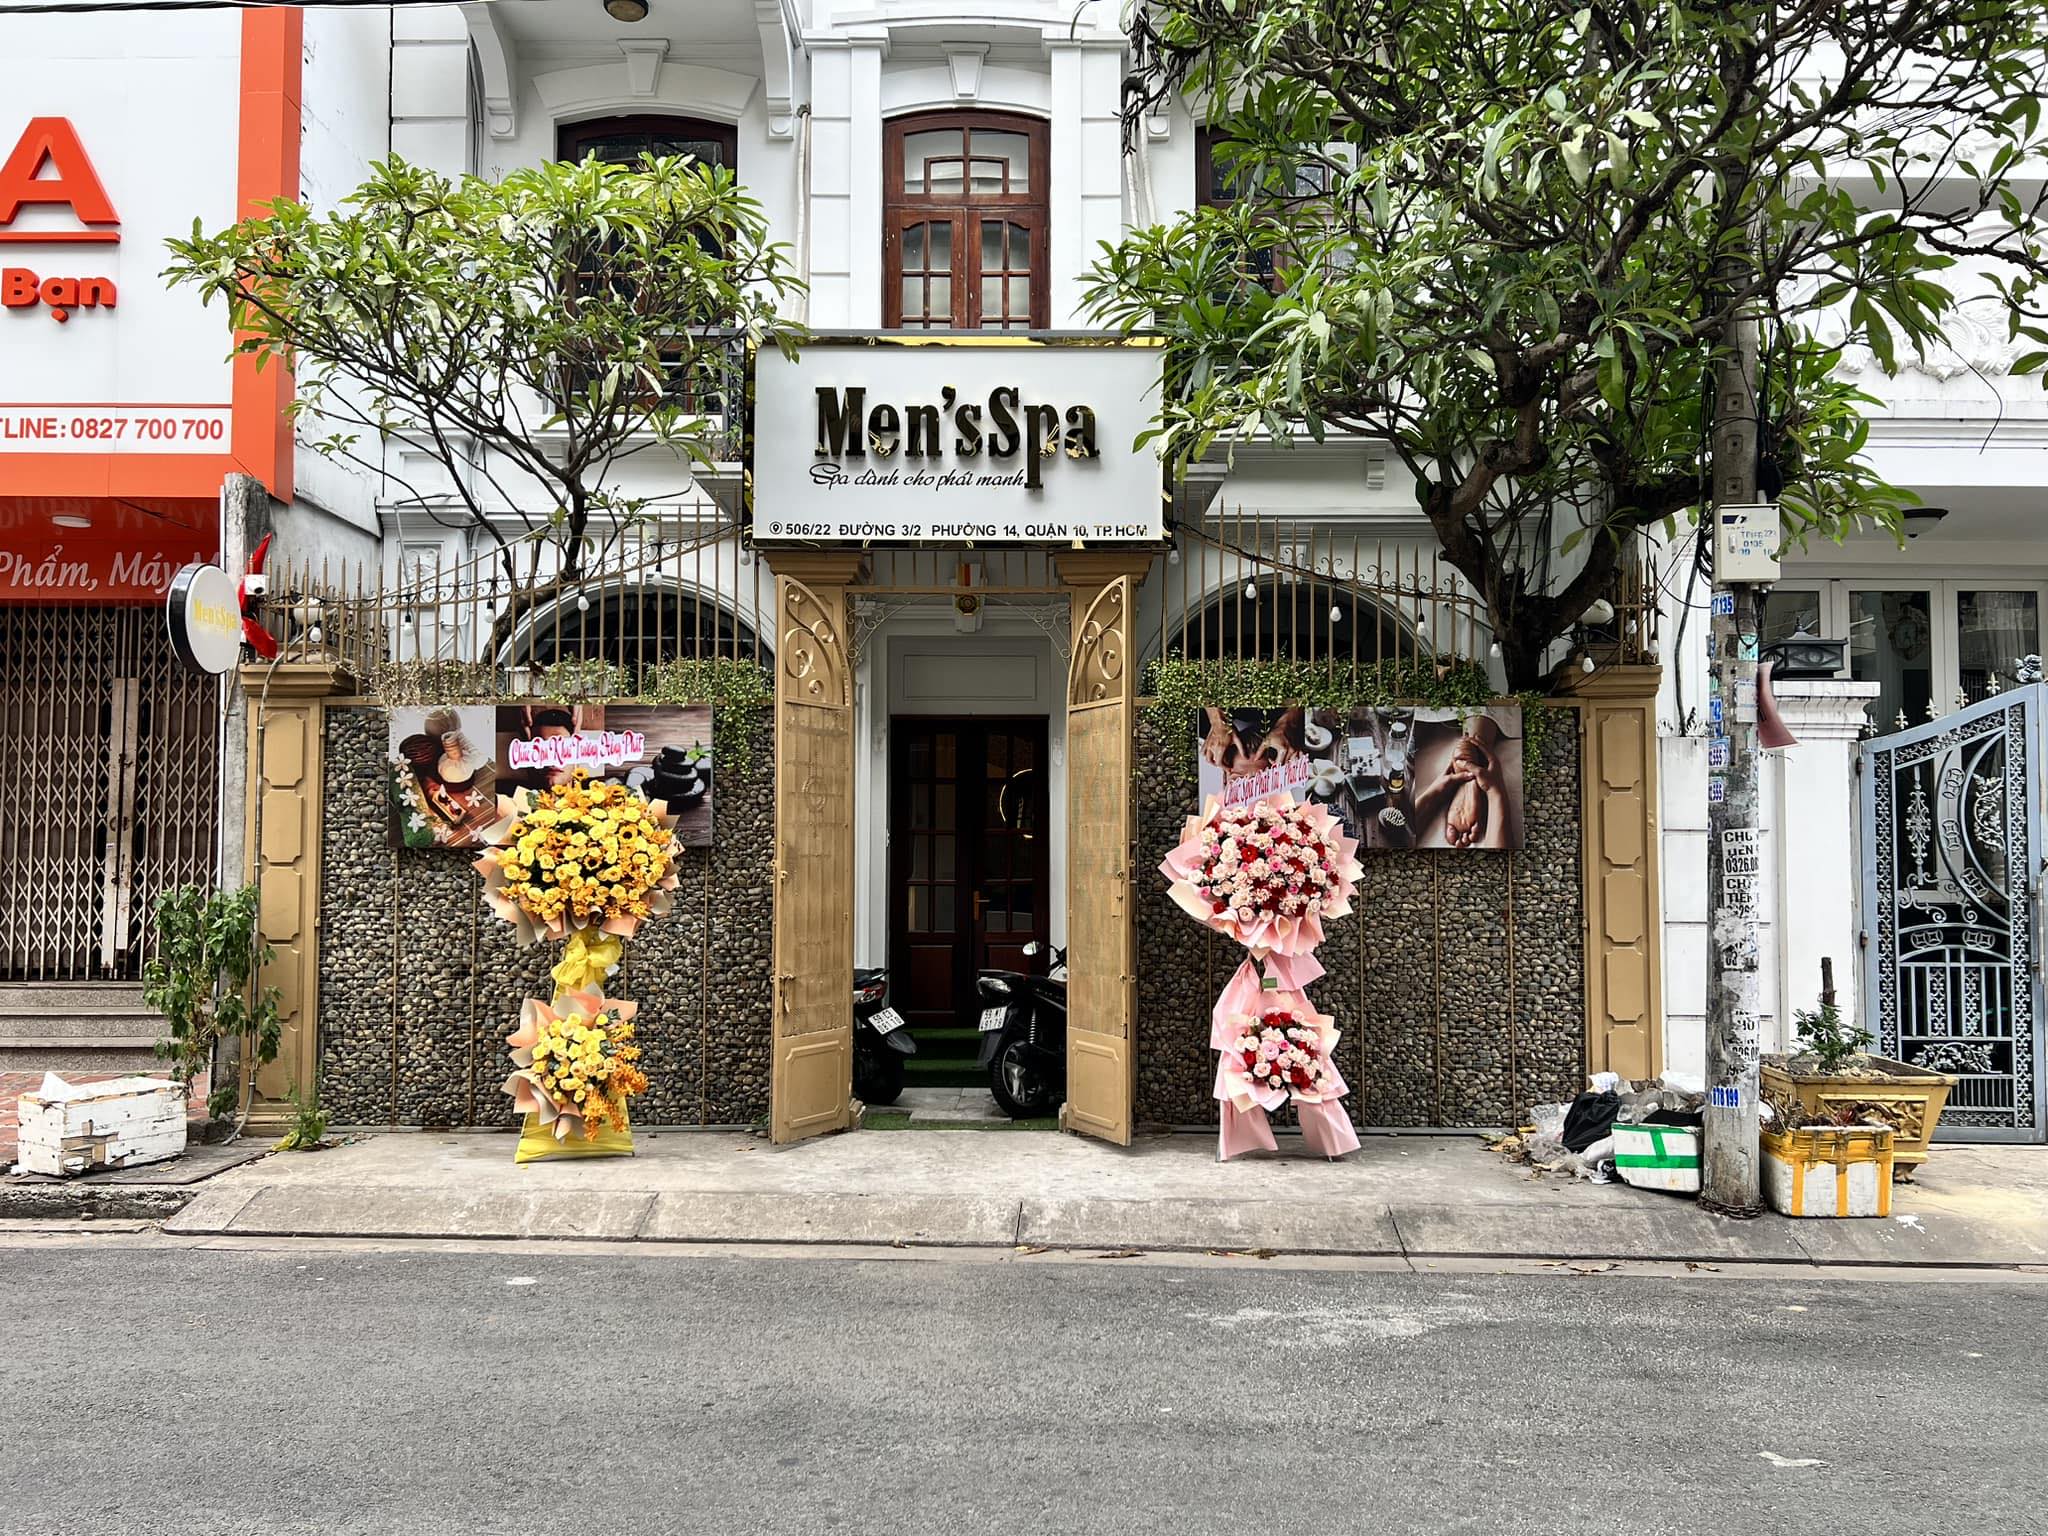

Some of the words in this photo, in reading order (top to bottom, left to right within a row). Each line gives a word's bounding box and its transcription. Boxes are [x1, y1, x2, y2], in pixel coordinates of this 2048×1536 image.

[1, 267, 116, 323] Bạn
[0, 417, 66, 439] LINE:
[70, 417, 128, 439] 0827
[134, 418, 177, 440] 700
[182, 418, 224, 440] 700
[809, 462, 849, 490] Spa
[854, 468, 899, 486] dành
[903, 469, 936, 486] cho
[785, 523, 831, 536] 506/22
[838, 521, 895, 536] ĐƯỜNG
[901, 524, 921, 536] 3/2
[931, 522, 996, 537] PHƯỜNG
[1003, 524, 1020, 538] 14,
[1073, 524, 1089, 538] 10,
